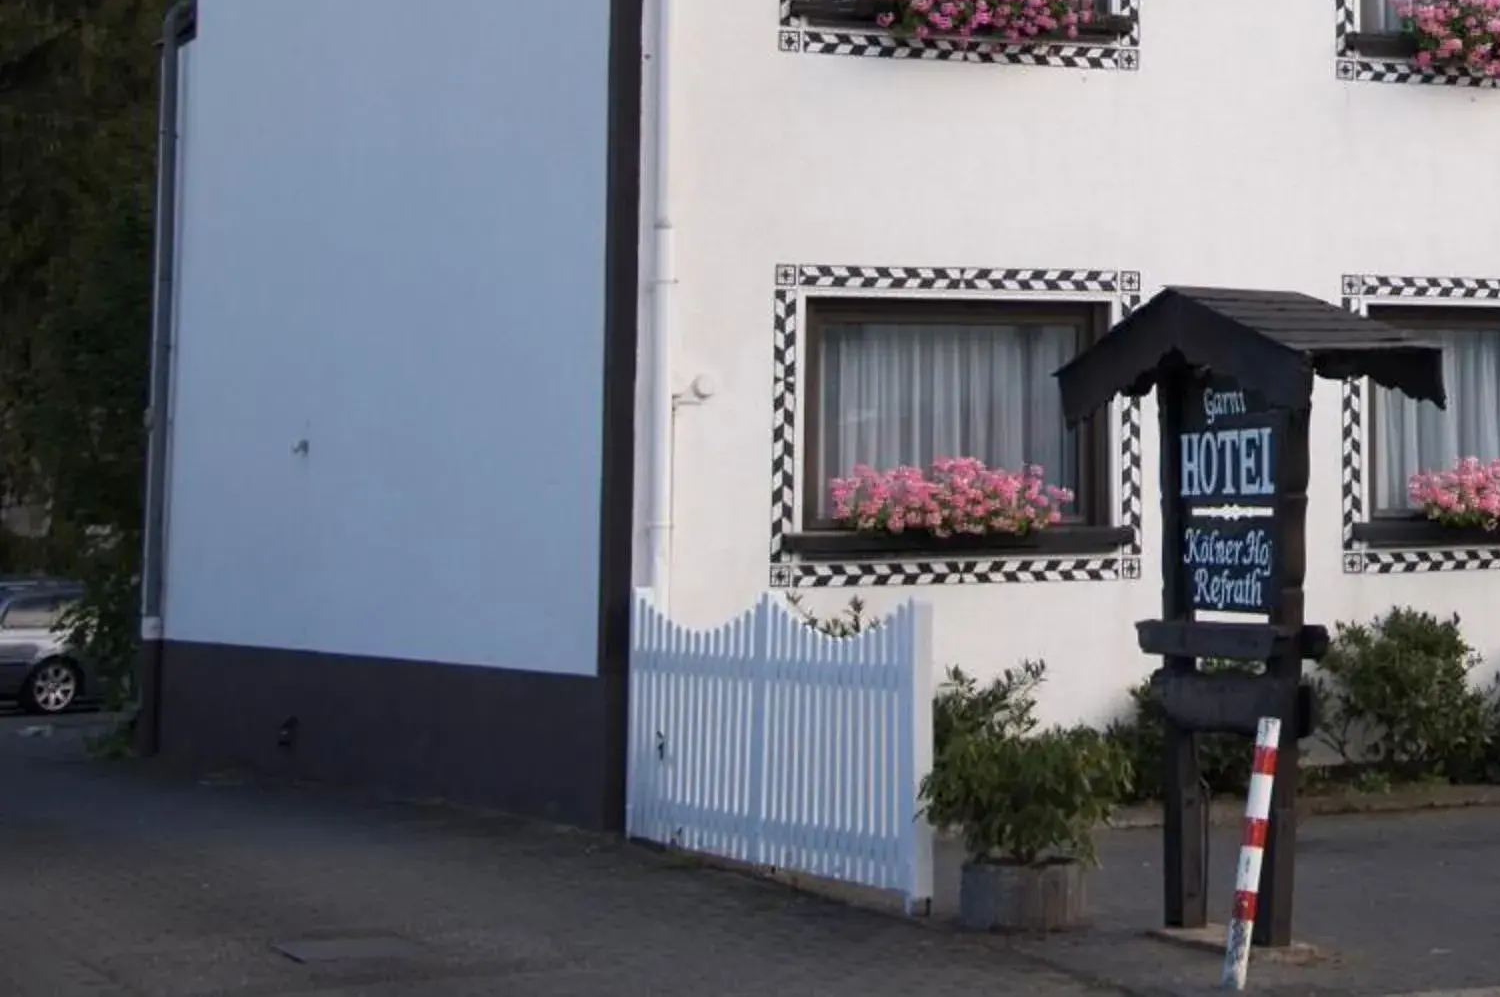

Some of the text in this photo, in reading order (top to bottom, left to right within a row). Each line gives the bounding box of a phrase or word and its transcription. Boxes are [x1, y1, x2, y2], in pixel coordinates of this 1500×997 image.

[1203, 387, 1247, 424] Garni
[1180, 427, 1275, 496] HOTEL
[1183, 527, 1243, 566] Kölner
[1193, 567, 1263, 609] Refrath
